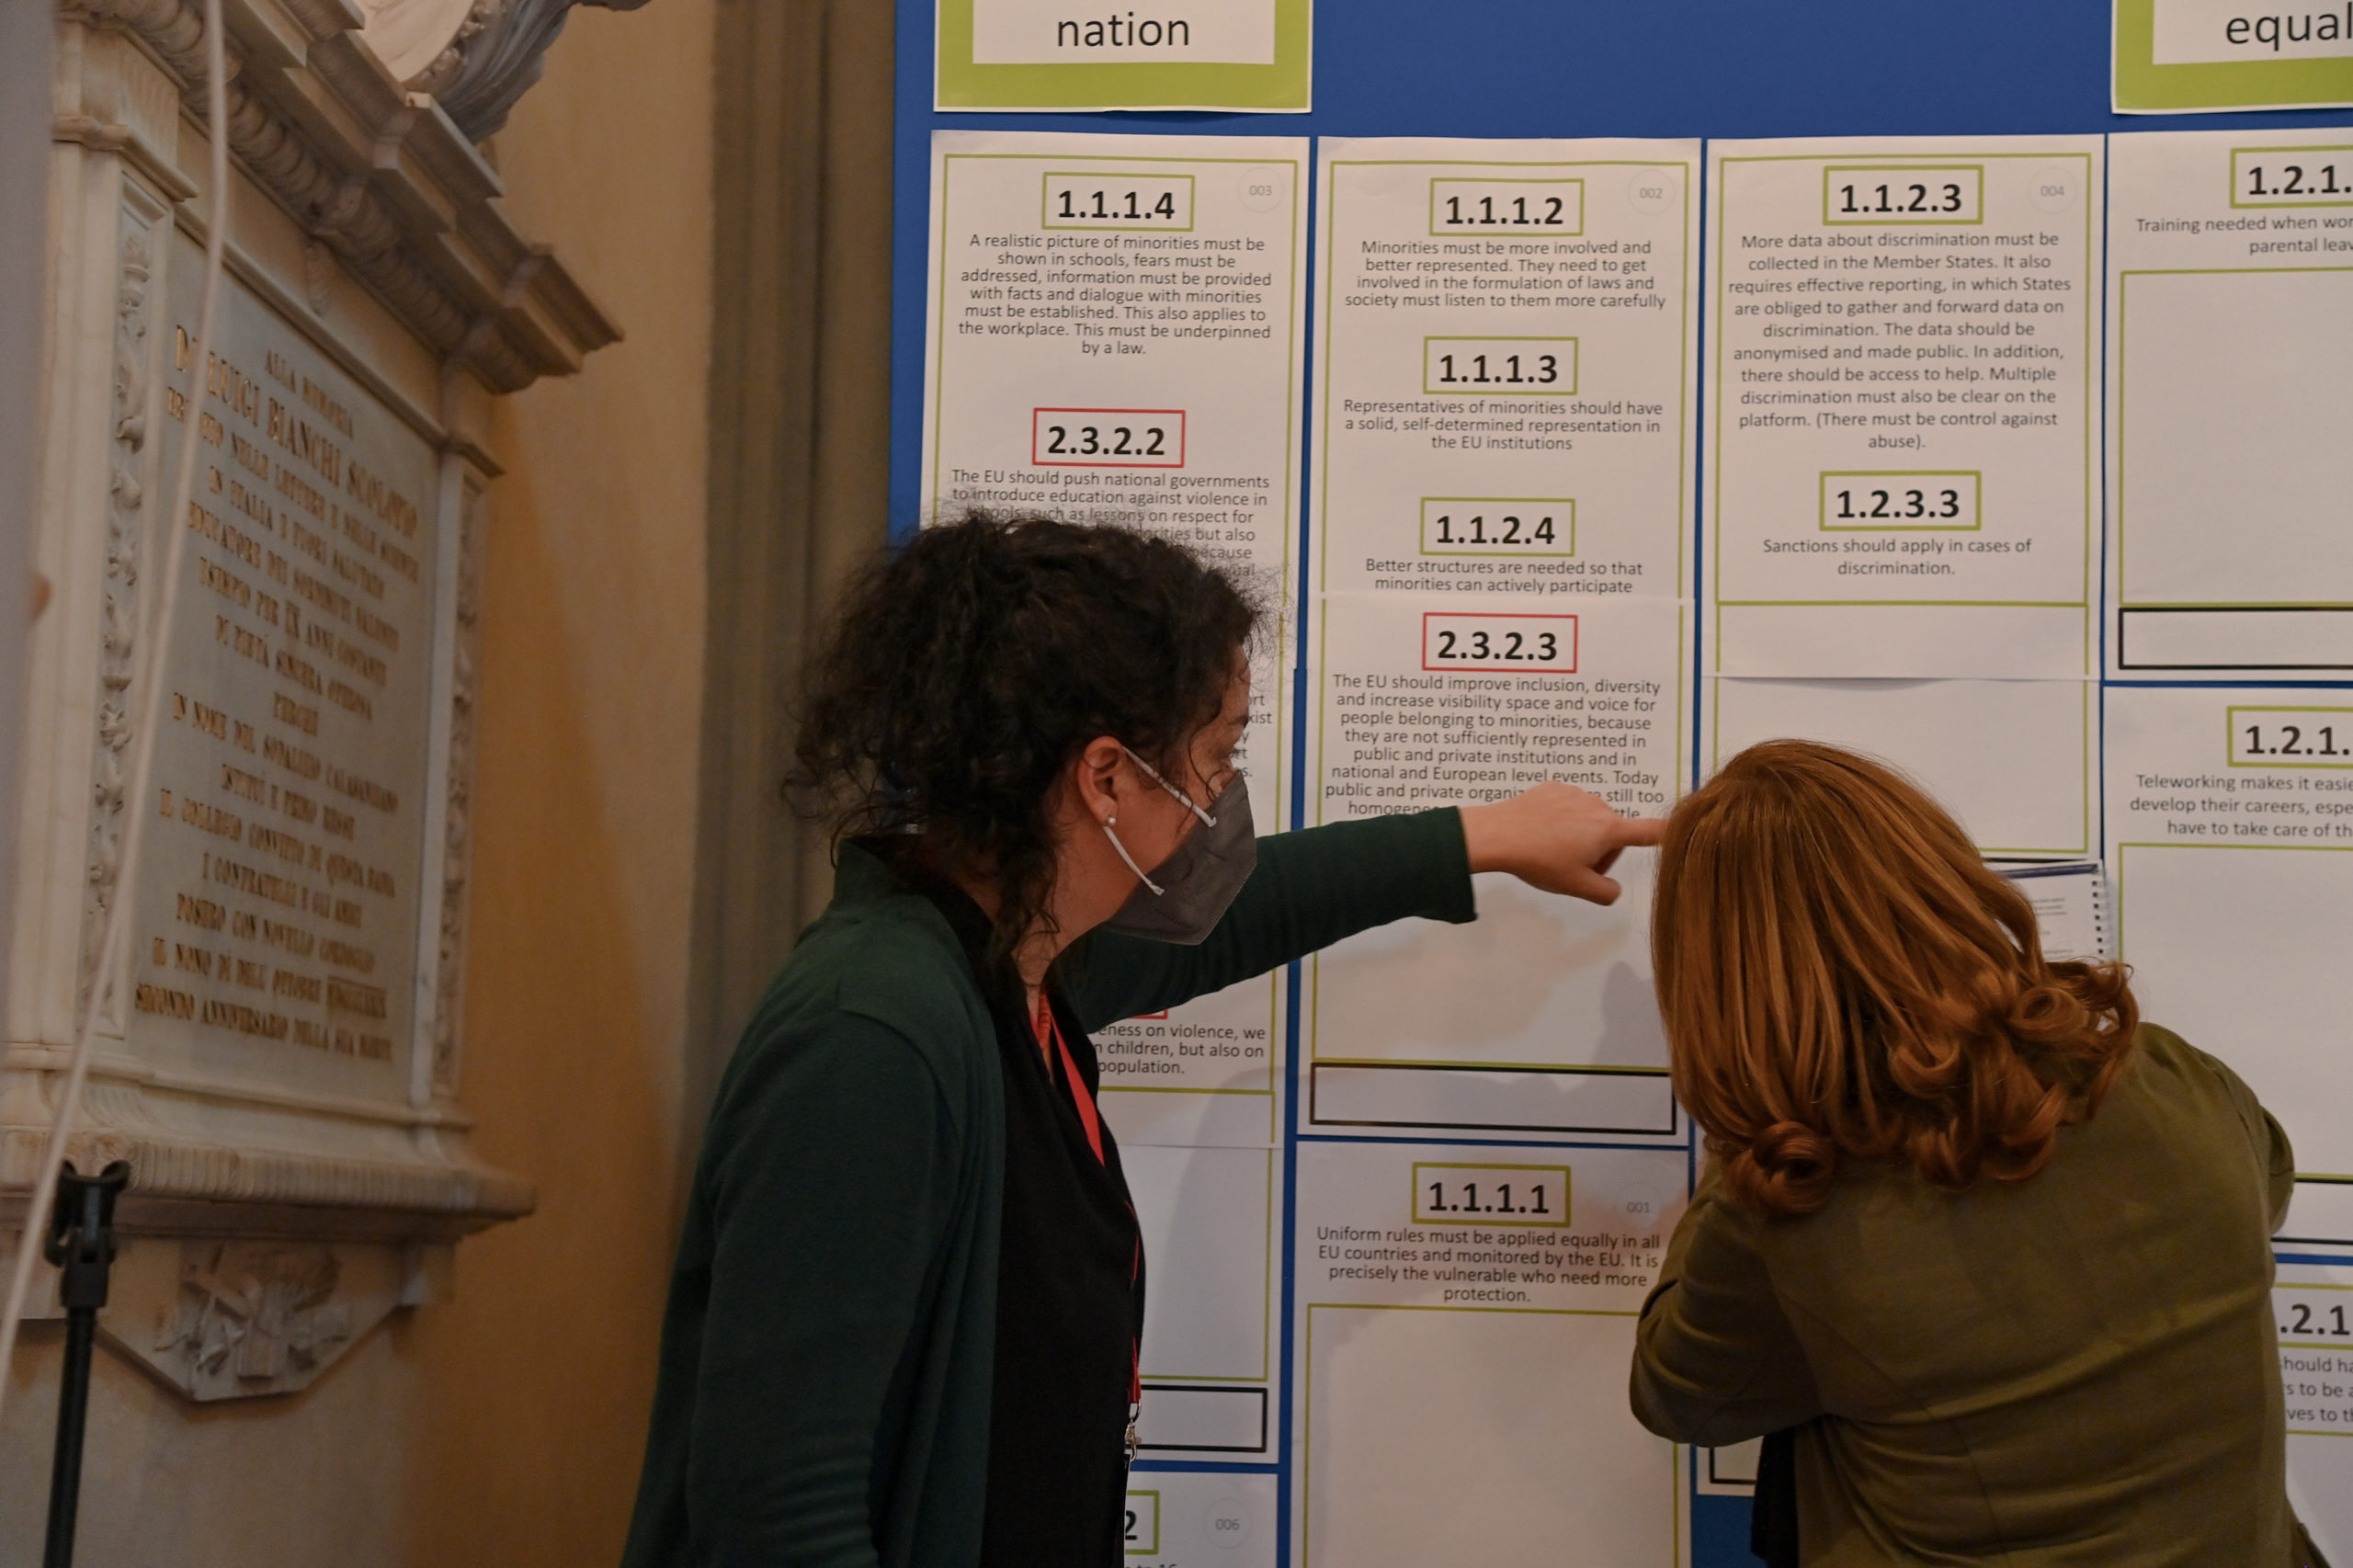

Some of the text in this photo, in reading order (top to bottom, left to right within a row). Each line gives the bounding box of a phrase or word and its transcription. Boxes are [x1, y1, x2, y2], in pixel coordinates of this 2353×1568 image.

[1057, 11, 1190, 47] nation
[1248, 183, 1274, 197] 003
[1639, 187, 1664, 199] 002
[1839, 182, 1962, 214] 1.1.2.3
[2040, 184, 2065, 198] 004
[1057, 189, 1176, 221] 1.1.1.4
[1445, 195, 1564, 226] 1.1.1.2
[2135, 216, 2201, 236] Training
[2204, 214, 2268, 232] needed
[2270, 213, 2318, 230] when
[969, 232, 1266, 252] A realistic picture of minorities must be
[1361, 239, 1652, 255] Minorities must be more involved and
[1741, 230, 2060, 248] More data about discrimination must be
[2249, 236, 2319, 256] parental
[1365, 257, 1647, 275] better represented. They need to get
[961, 267, 1272, 289] addressed, information must be provided
[969, 285, 1263, 305] with facts and dialogue with minorities
[1439, 353, 1558, 384] 1.1.1.3
[1343, 397, 1664, 416] Representatives of minorities should have
[208, 350, 260, 426] LUIGI
[267, 396, 341, 485] BIANCHI
[1047, 425, 1166, 457] 2.3.2.2
[950, 468, 1270, 492] The EU should push national governments
[1836, 488, 1961, 520] 1.2.3.3
[1436, 515, 1556, 546] 1.1.2.4
[1763, 537, 2033, 556] Sanctions should apply in cases of
[1366, 557, 1643, 575] Better structures are needed so that
[1836, 559, 1956, 575] discrimination.
[1374, 575, 1633, 597] minorities can actively participate
[1437, 630, 1558, 662] 2.3.2.3
[2135, 772, 2236, 792] Teleworking
[2240, 774, 2294, 790] makes
[2298, 775, 2310, 790] it
[2129, 794, 2197, 815] develop
[2200, 796, 2241, 812] their
[2244, 801, 2311, 815] careers,
[2166, 818, 2207, 835] have
[2210, 821, 2229, 835] to
[2232, 819, 2269, 835] take
[2272, 824, 2309, 836] care
[2312, 821, 2332, 837] of
[1097, 1022, 1267, 1040] eness on violence, we
[1107, 1039, 1265, 1058] children, but also on
[1428, 1181, 1551, 1215] 1.1.1.1
[1626, 1201, 1651, 1214] 001
[1316, 1224, 1661, 1251] Uniform rules must be applied equally in all
[1328, 1263, 1648, 1286] precisely the vulnerable who need more
[2279, 1302, 2351, 1336] .2.1
[2280, 1356, 2332, 1372] hould
[2300, 1382, 2343, 1397] to be
[1215, 1517, 1241, 1531] 006
